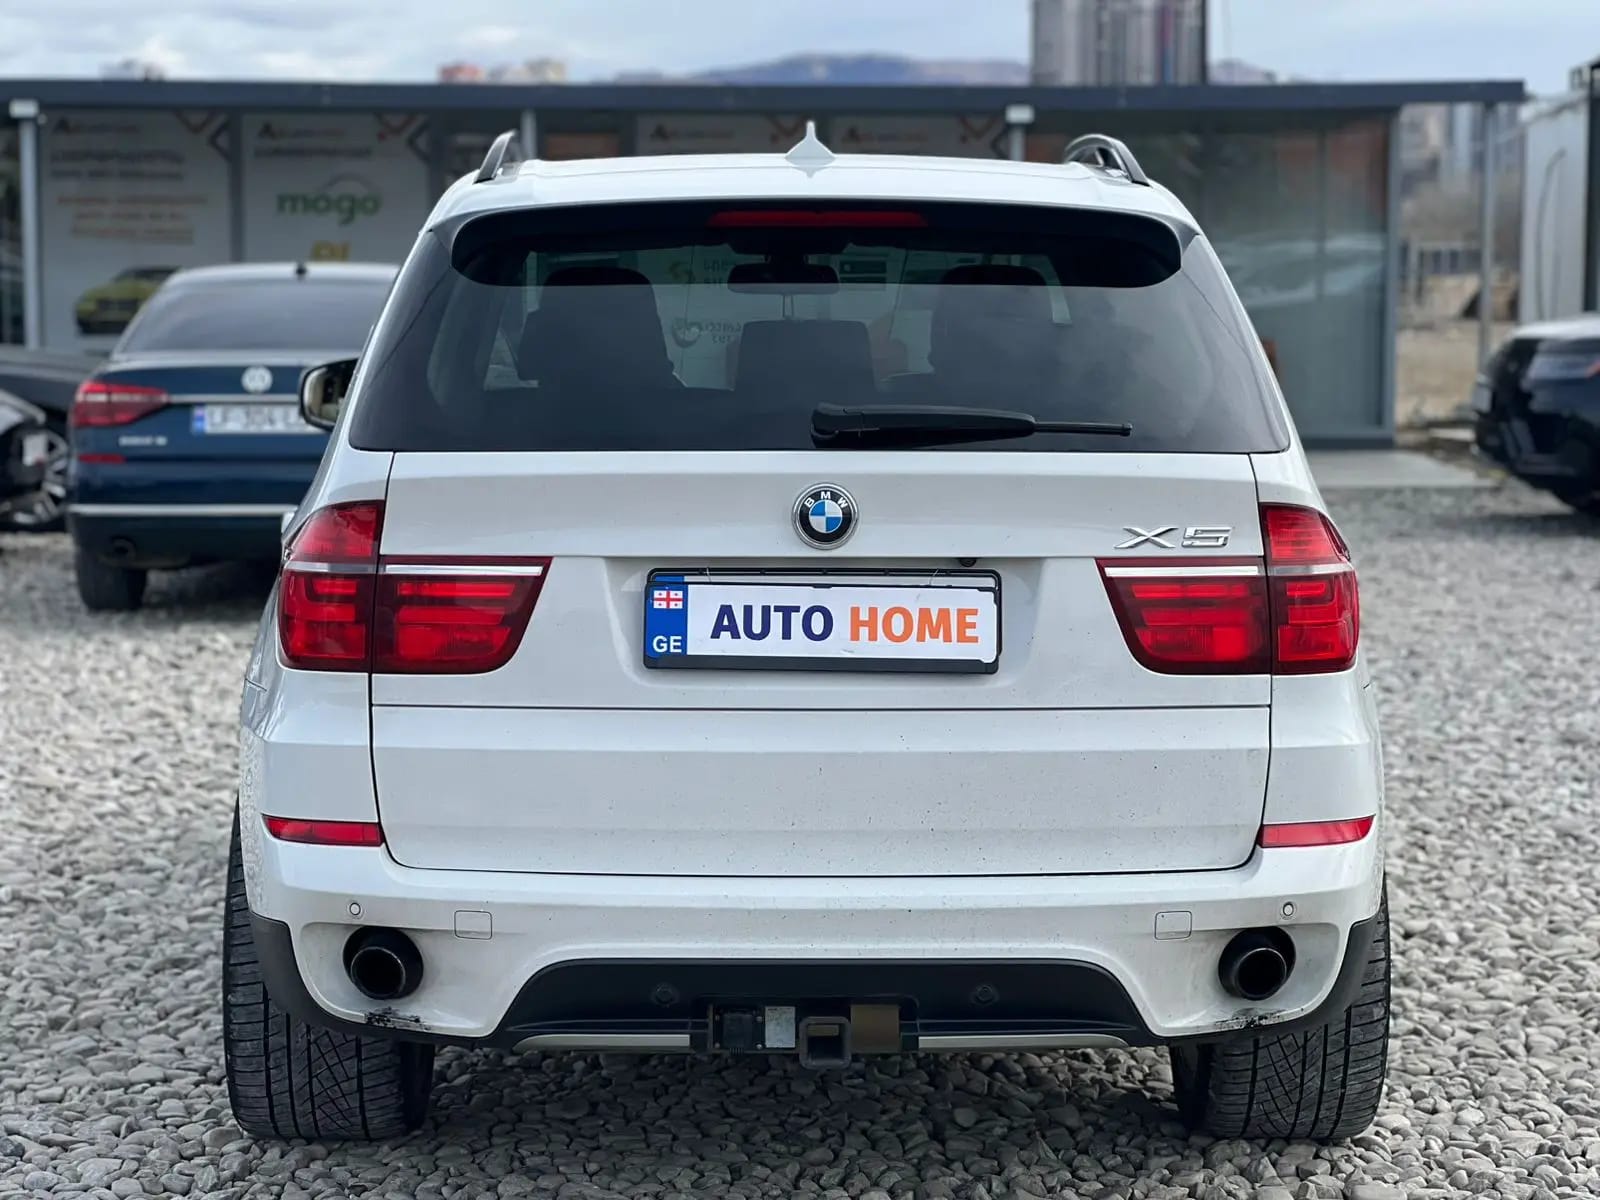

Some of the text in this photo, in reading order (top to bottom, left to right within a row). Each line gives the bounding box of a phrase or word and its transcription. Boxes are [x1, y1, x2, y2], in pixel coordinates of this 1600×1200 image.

[277, 191, 382, 225] mogo
[804, 490, 849, 509] BMW
[1113, 526, 1232, 550] X5
[710, 604, 980, 644] AUTO HOME
[652, 635, 683, 654] GE
